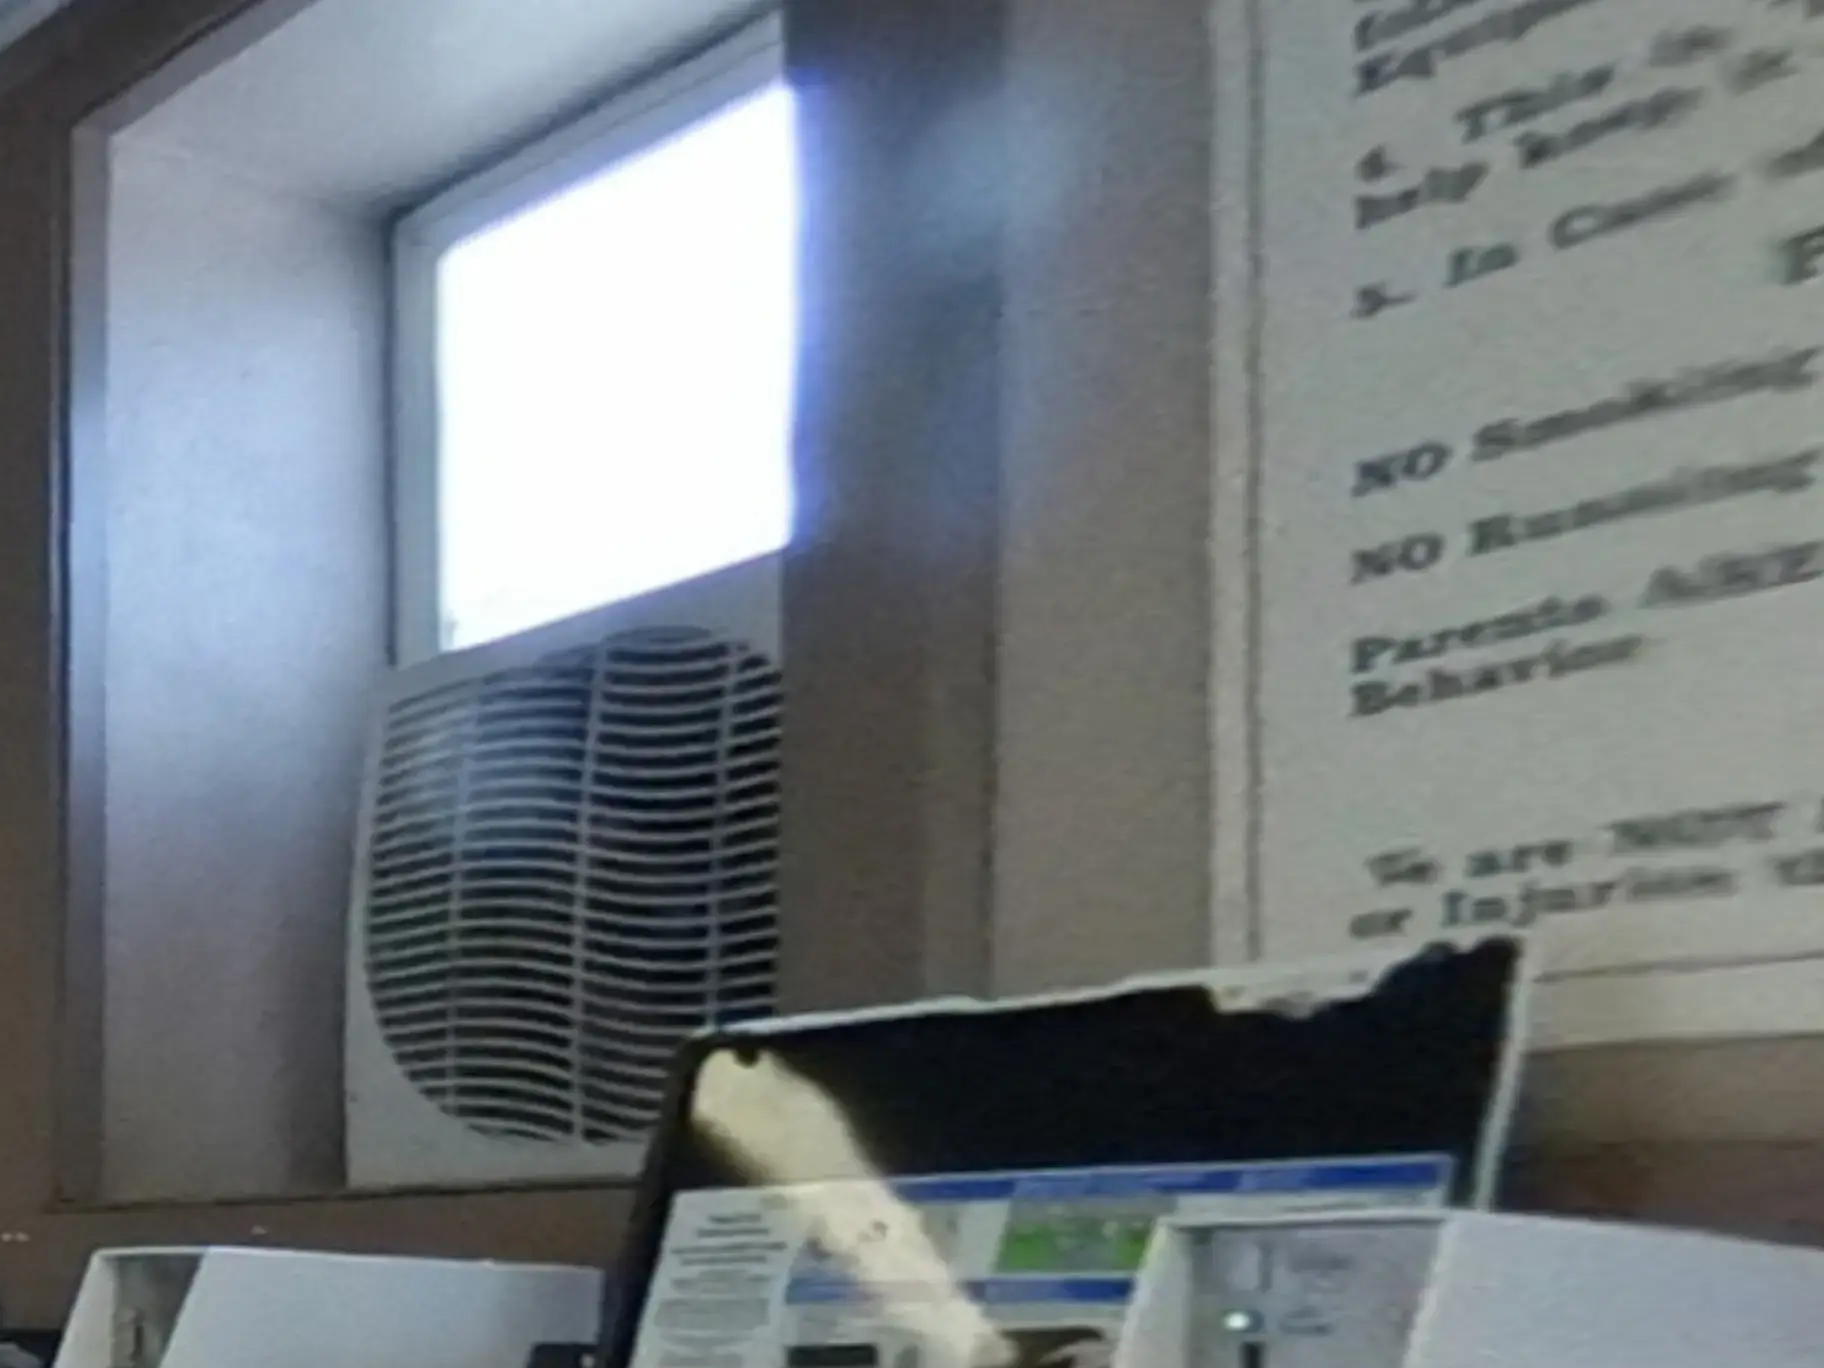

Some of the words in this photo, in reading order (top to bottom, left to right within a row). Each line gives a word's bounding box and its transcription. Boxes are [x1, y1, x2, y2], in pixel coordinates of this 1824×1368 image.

[1352, 440, 1452, 496] NO
[1470, 346, 1824, 462] Smoking
[1350, 532, 1446, 584] NO
[1467, 450, 1824, 555] Running
[1350, 634, 1647, 716] Behavior
[1352, 594, 1609, 672] Parents
